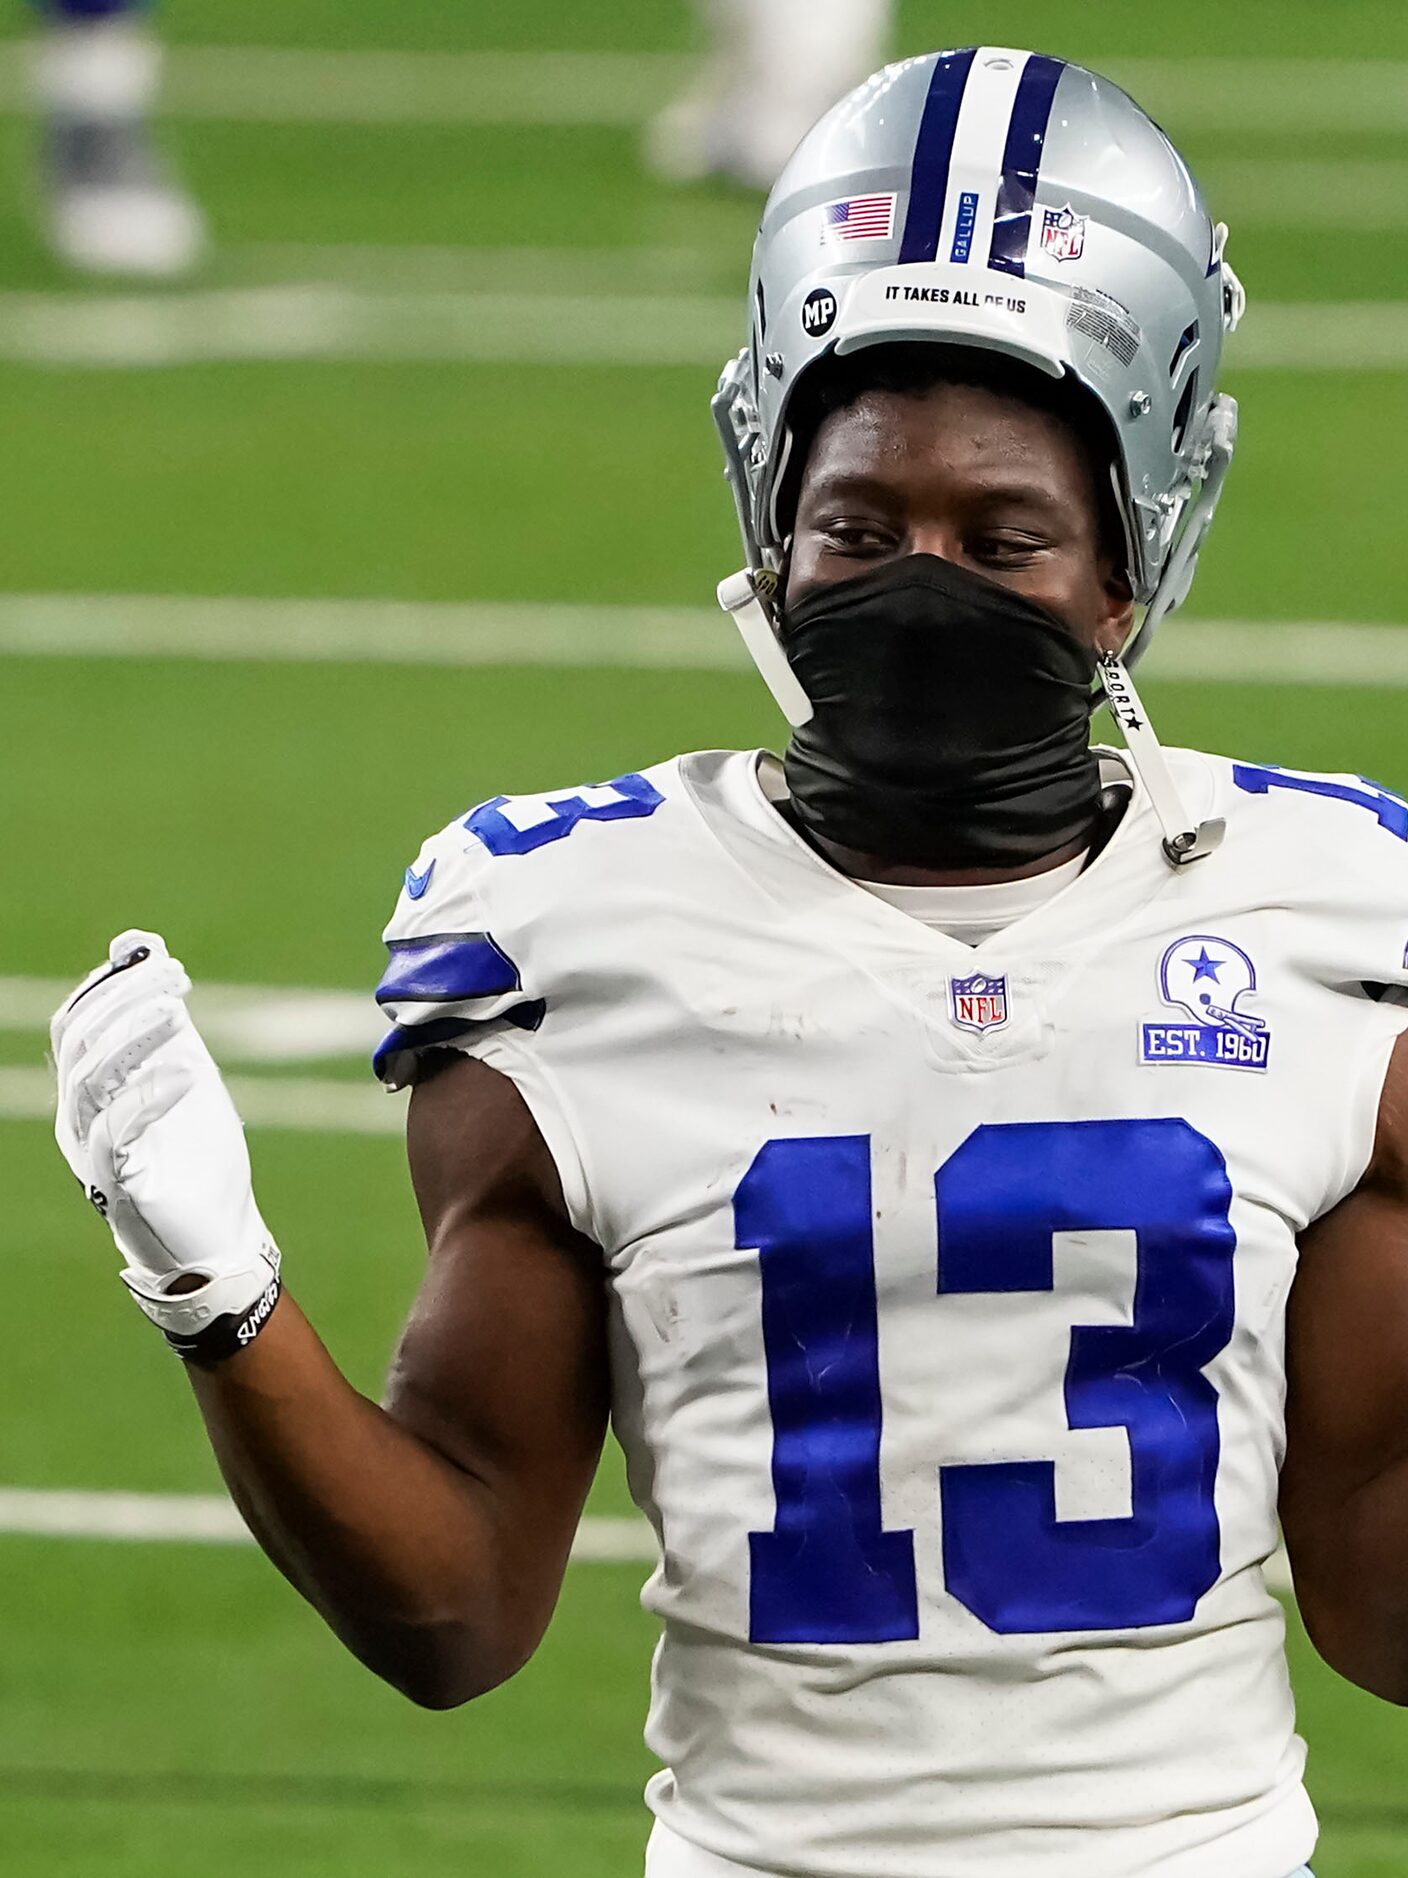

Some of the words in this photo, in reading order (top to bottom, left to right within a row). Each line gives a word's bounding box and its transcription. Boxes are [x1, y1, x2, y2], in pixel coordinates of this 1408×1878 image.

[955, 195, 975, 257] GALLUP
[804, 297, 834, 329] MP
[886, 286, 900, 300] IT
[903, 287, 950, 303] TAKES
[952, 290, 980, 306] ALL
[1006, 298, 1026, 314] US
[958, 996, 1004, 1024] NFL
[1147, 1029, 1206, 1057] EST.
[1216, 1032, 1268, 1062] 1960
[731, 1116, 1237, 1644] 13
